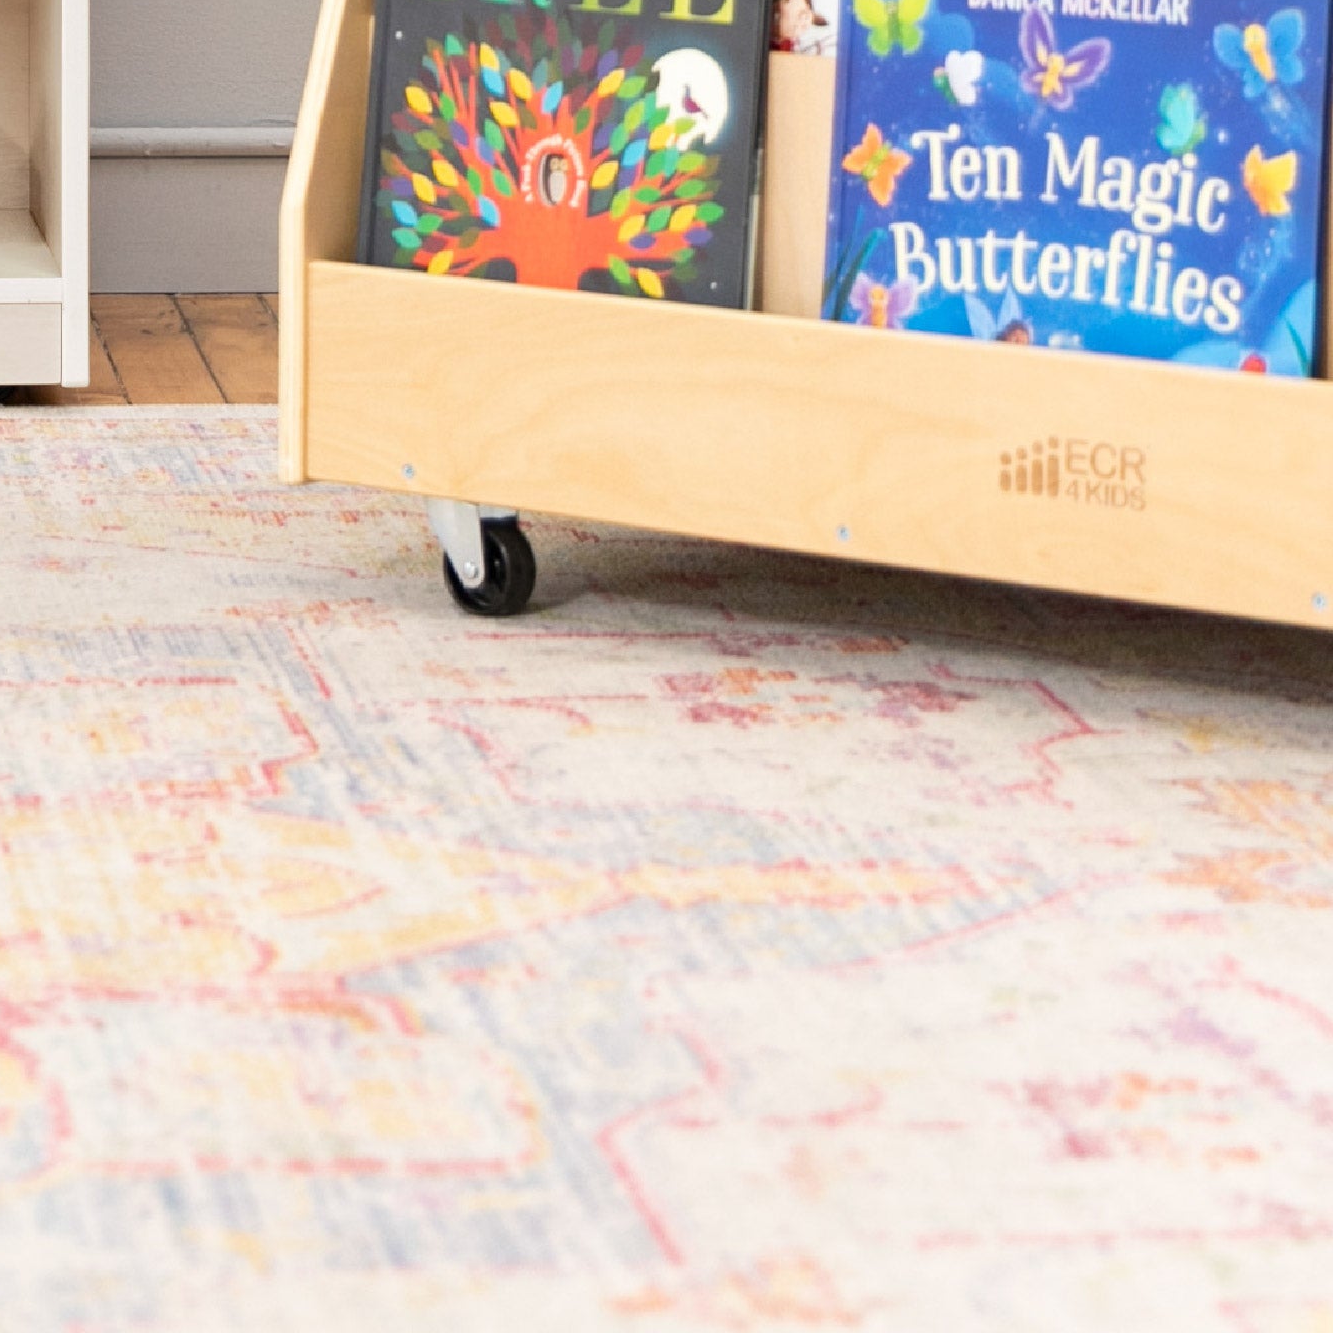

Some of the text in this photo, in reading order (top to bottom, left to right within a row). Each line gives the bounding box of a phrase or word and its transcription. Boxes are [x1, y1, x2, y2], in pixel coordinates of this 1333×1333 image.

[909, 123, 1231, 234] Ten Magic
[889, 221, 1245, 334] Butterflies
[1064, 437, 1147, 483] ECR
